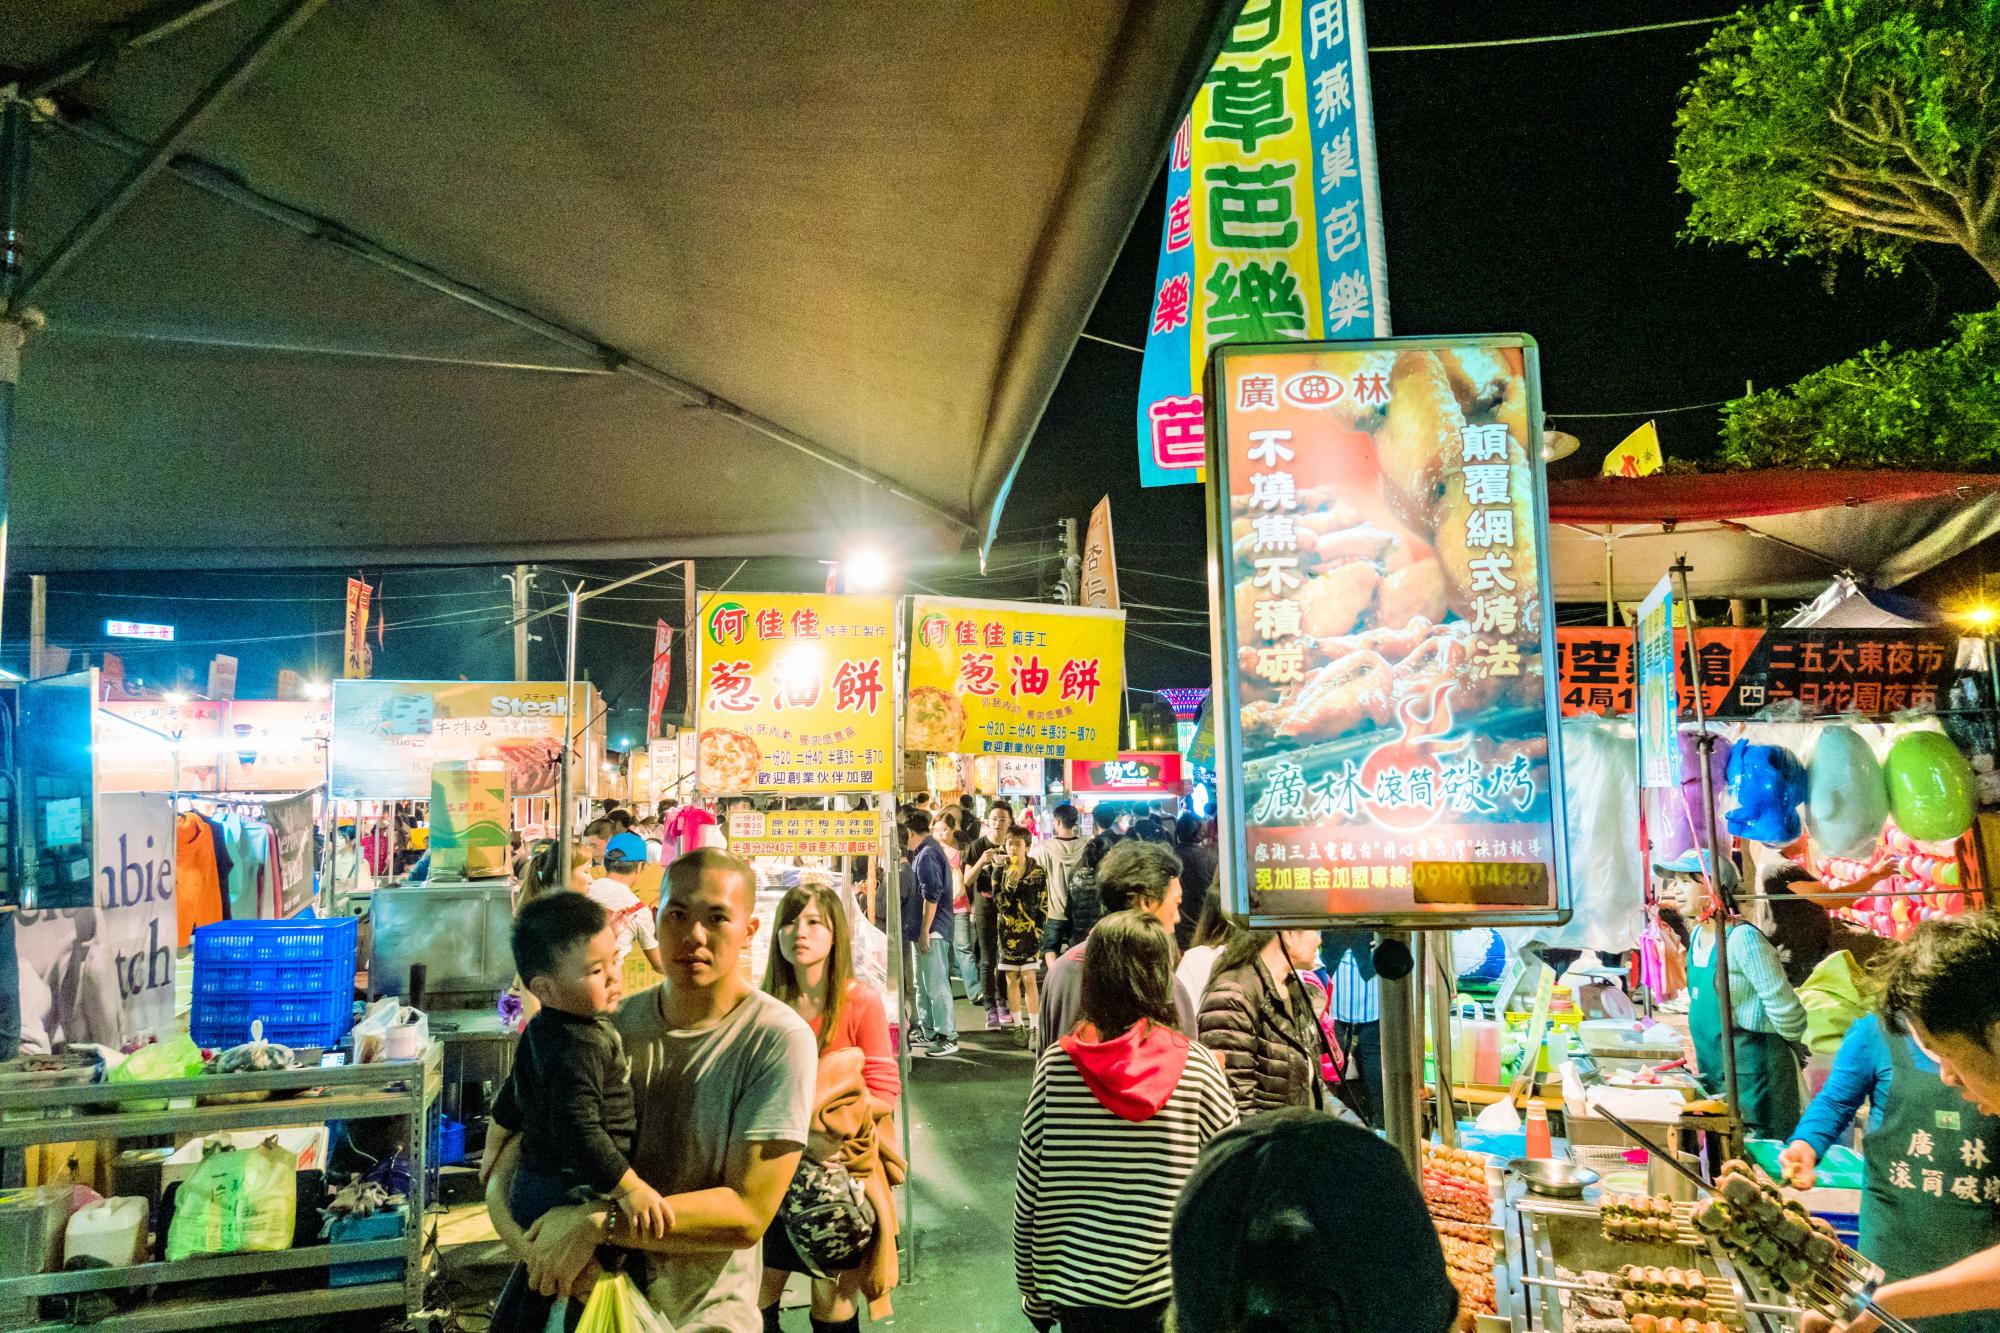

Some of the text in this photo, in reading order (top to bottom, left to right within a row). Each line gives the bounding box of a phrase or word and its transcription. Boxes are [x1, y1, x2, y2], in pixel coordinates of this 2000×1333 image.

[1309, 0, 1370, 333] 用燕巢芭樂
[1247, 429, 1305, 682] 不燒焦不積碳
[1460, 423, 1521, 679] 顛覆網式烤法
[1085, 543, 1107, 608] 杏仁
[712, 607, 887, 643] 何佳佳 純手工製作
[921, 618, 1048, 647] 何佳佳 純手工
[1556, 638, 1735, 687] 空槍
[1768, 640, 1945, 675] 二五大東夜市
[491, 695, 577, 718] Steak
[525, 693, 557, 701] ステーキ
[978, 721, 1096, 741] 一份20 二份40 半張35 一張70
[765, 749, 883, 766] 一份20 二份40 半張35 一張70
[983, 740, 1065, 757] 歡迎創業伙伴加盟
[758, 770, 873, 785] 歡迎創業伙伴加盟
